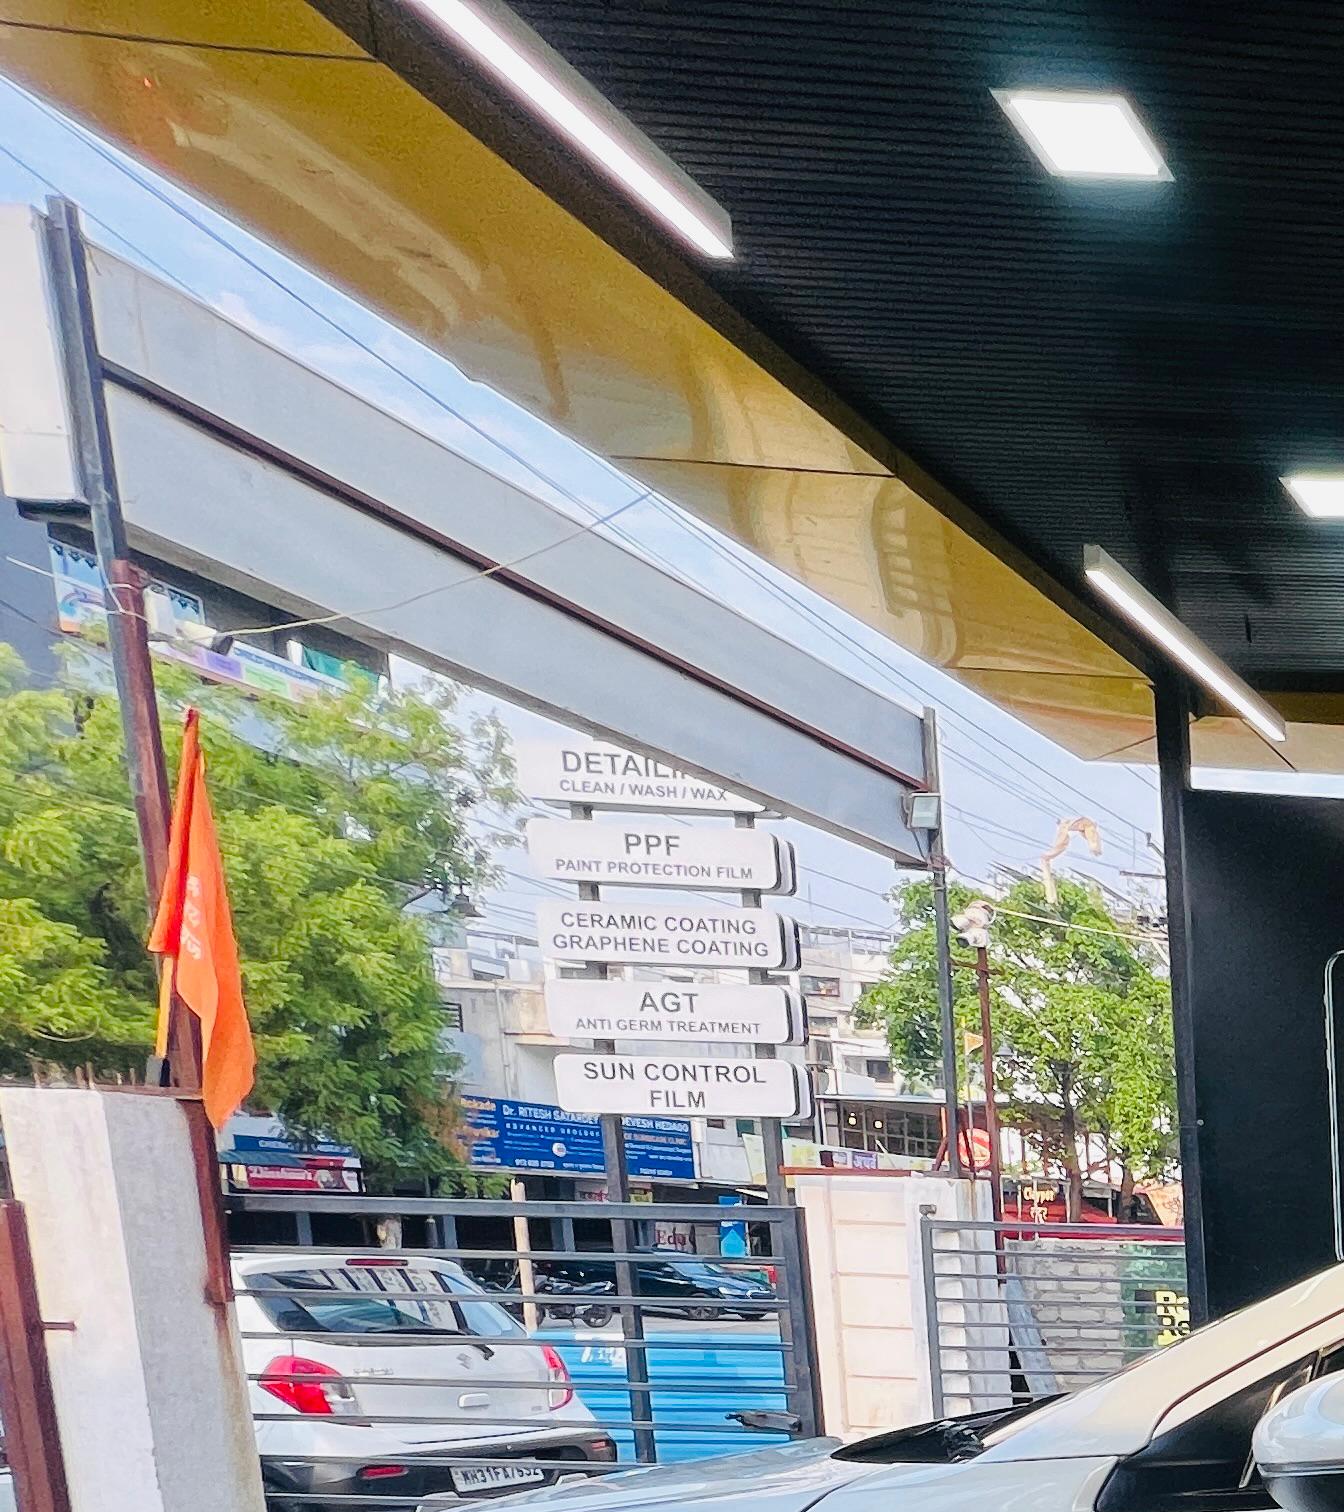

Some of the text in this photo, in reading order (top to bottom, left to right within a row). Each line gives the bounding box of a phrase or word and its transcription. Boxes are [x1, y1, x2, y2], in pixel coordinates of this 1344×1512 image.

[561, 750, 696, 780] DETAIL
[559, 779, 615, 795] CLEAN
[629, 784, 677, 799] WASH
[691, 787, 728, 801] WAX
[624, 832, 681, 857] PPF
[555, 858, 753, 880] PAINT PROTECTION FILM
[560, 912, 757, 935] CERAMIC COATING
[552, 934, 769, 957] GRAPHENE COATING
[639, 991, 699, 1013] AGT
[575, 1018, 761, 1035] ANTI GERM TREATMENT
[583, 1061, 767, 1085] SUN CONTROL
[649, 1089, 707, 1109] FILM
